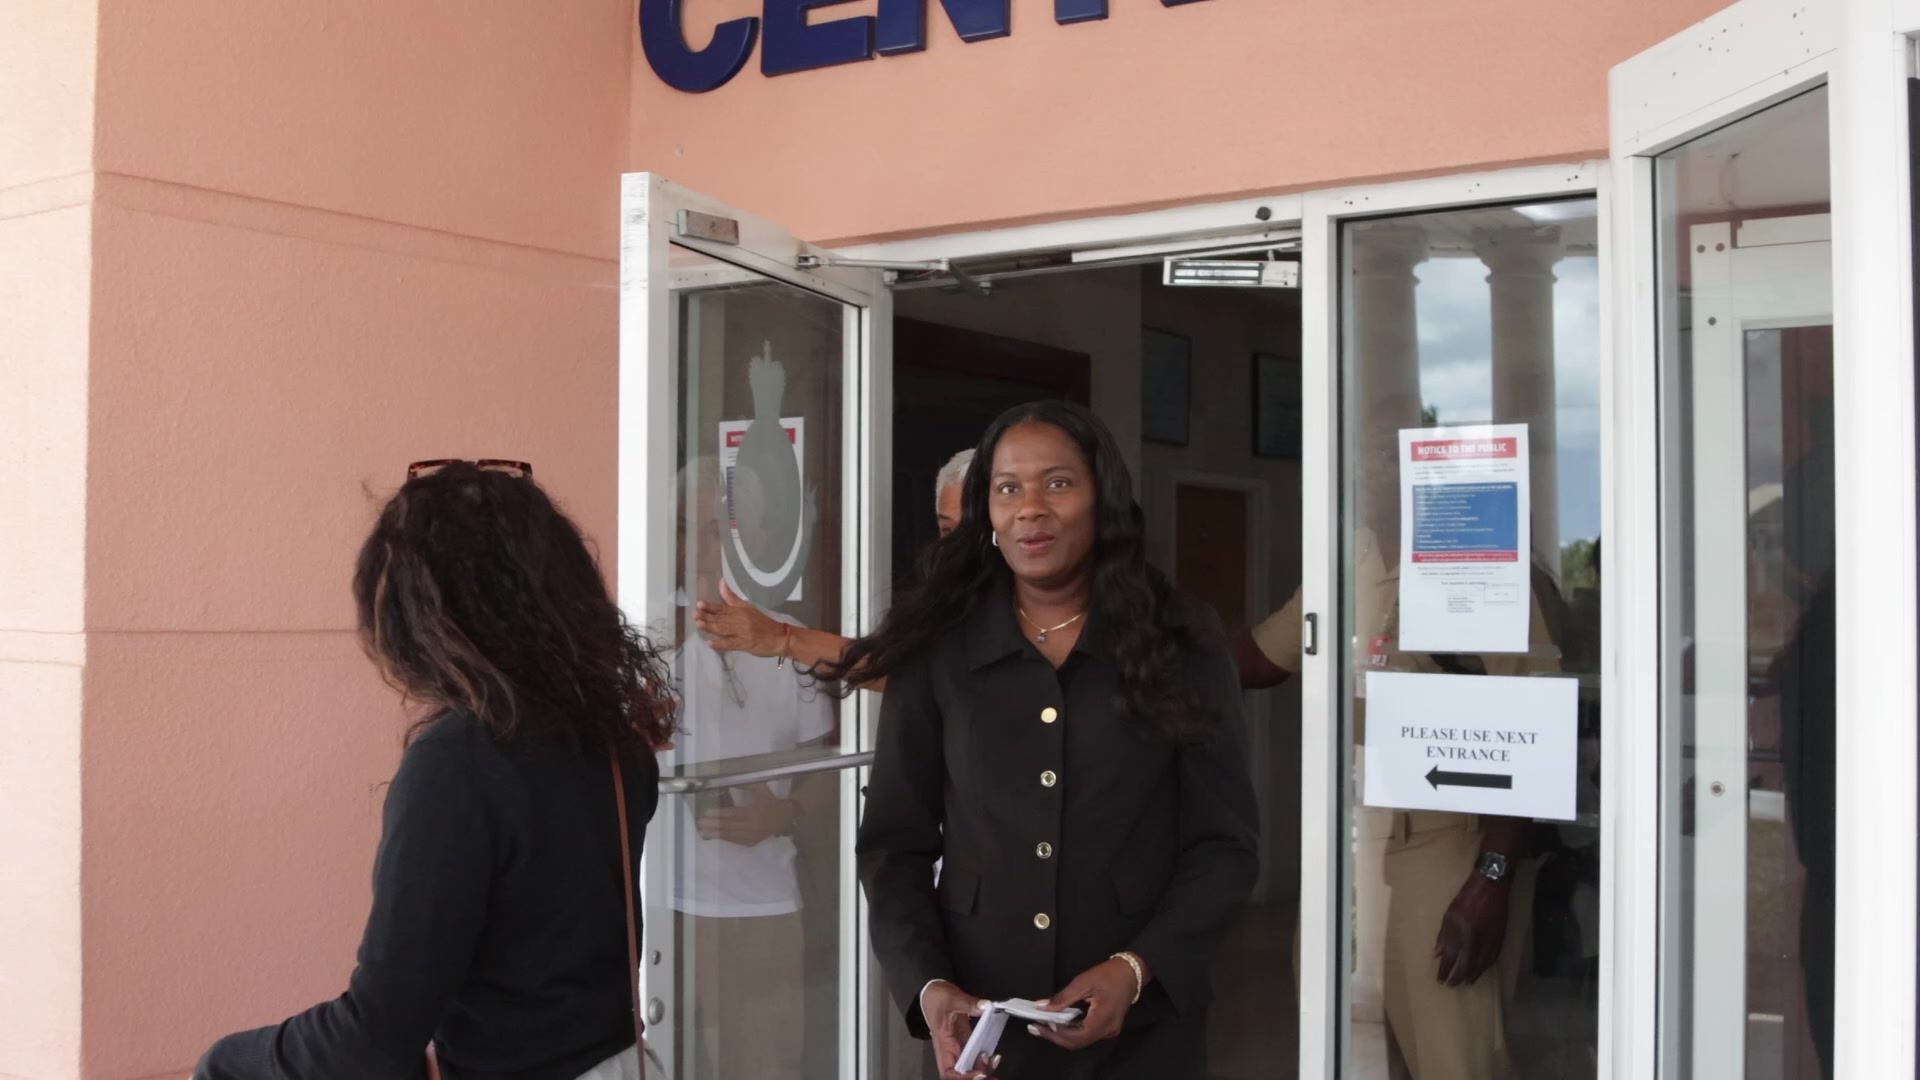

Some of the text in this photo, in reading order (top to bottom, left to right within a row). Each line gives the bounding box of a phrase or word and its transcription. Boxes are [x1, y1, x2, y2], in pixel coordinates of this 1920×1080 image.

[1417, 442, 1507, 455] NOTICE TO THE PUBLIC
[1401, 727, 1539, 744] PLEASE USE NEXT
[1426, 746, 1511, 762] ENTRANCE
